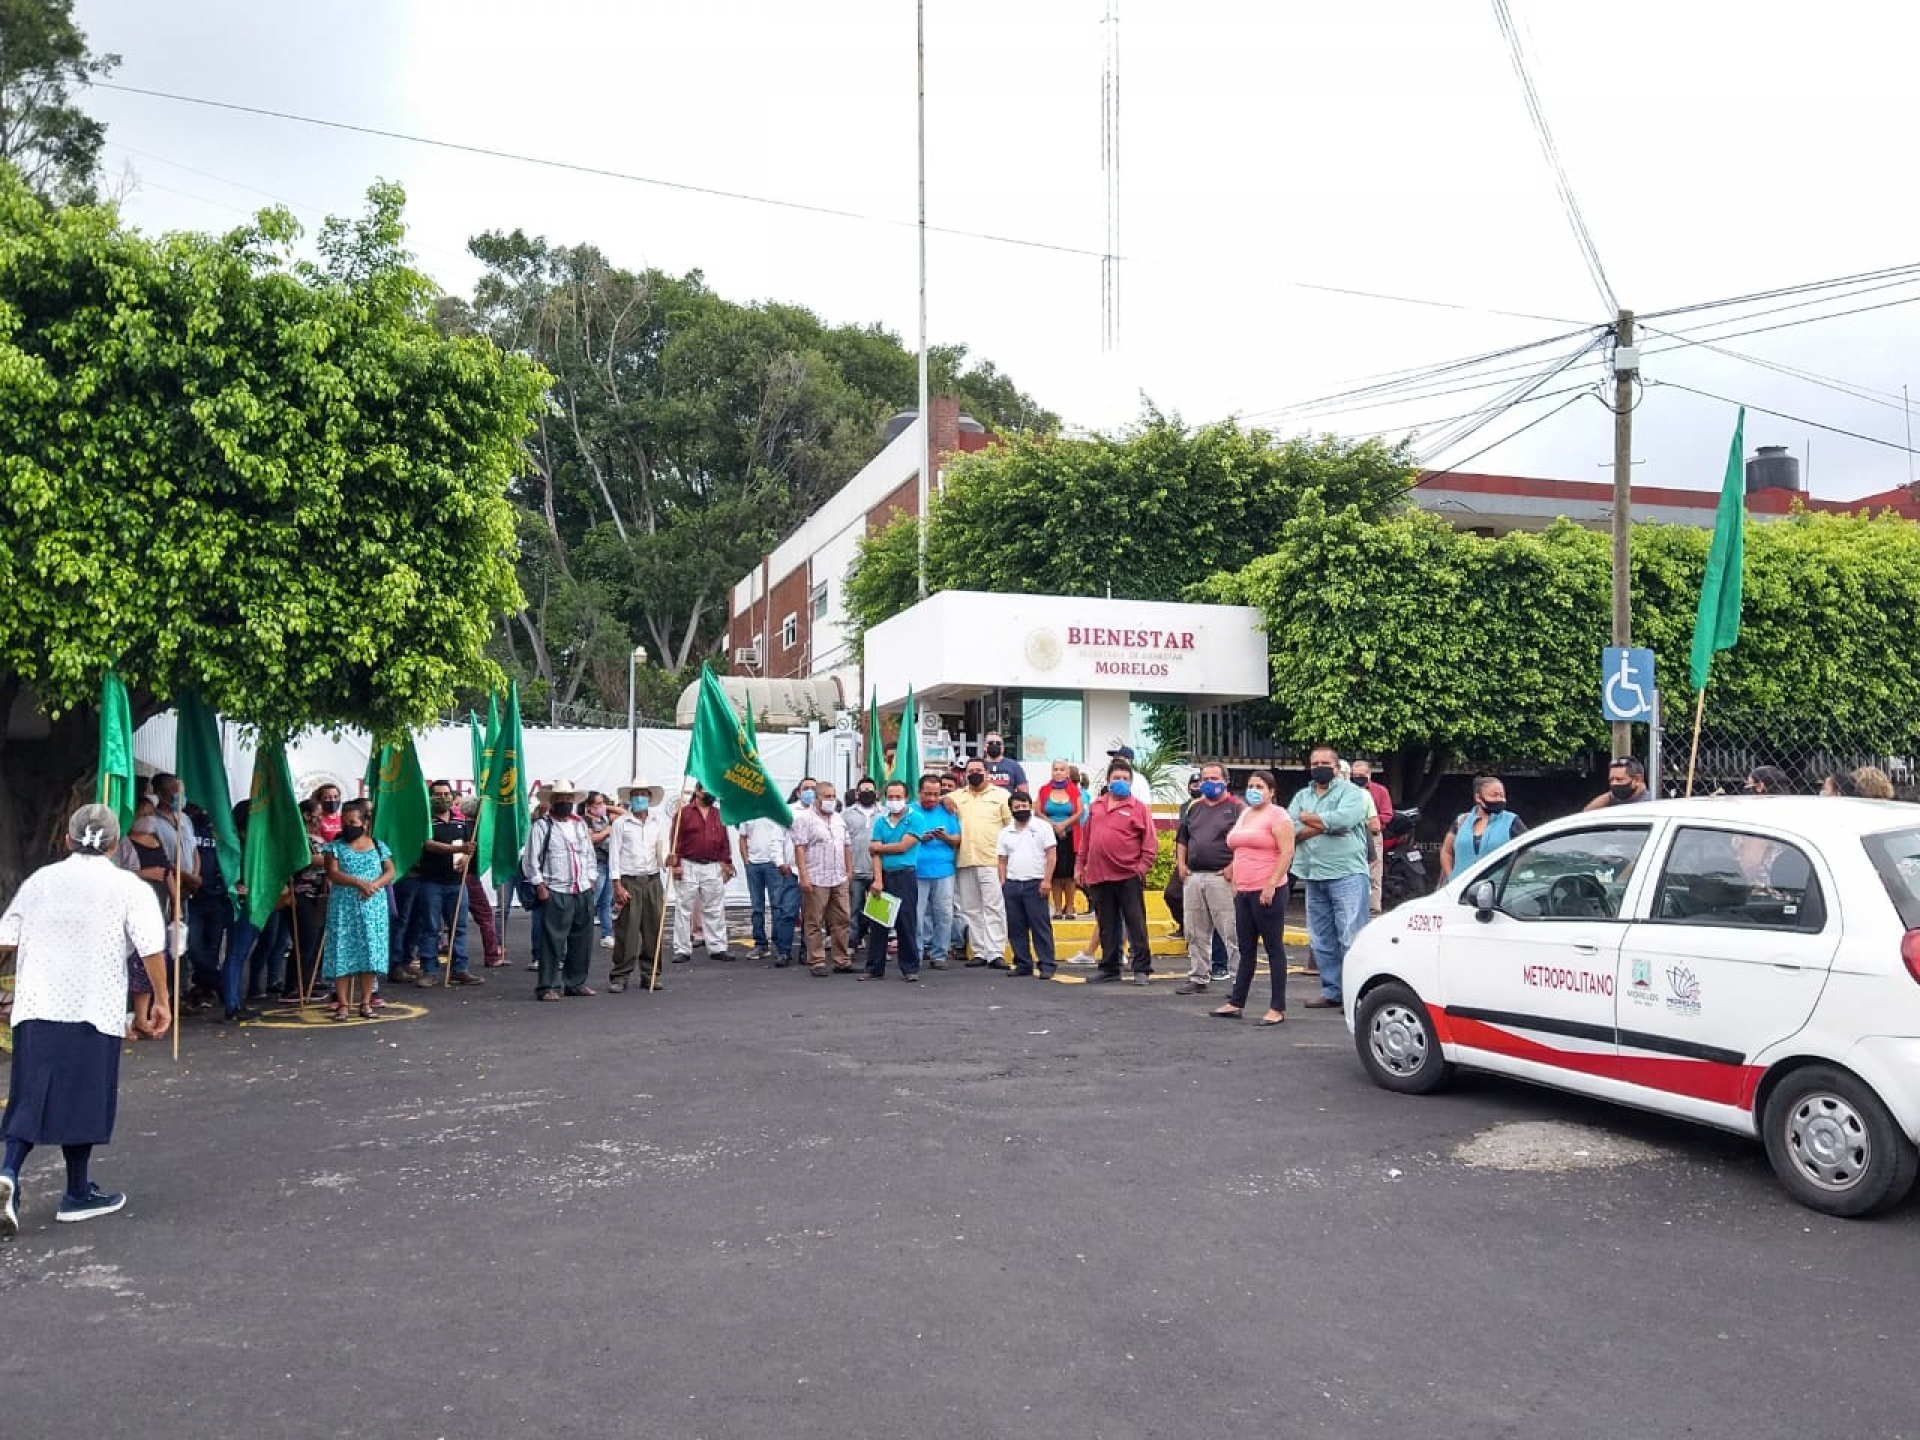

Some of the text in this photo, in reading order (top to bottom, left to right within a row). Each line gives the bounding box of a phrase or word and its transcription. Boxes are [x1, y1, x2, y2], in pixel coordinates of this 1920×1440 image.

[1068, 626, 1195, 650] BIENESTAR
[1095, 661, 1168, 676] MORELOS
[1523, 963, 1614, 997] METROPOLITANO
